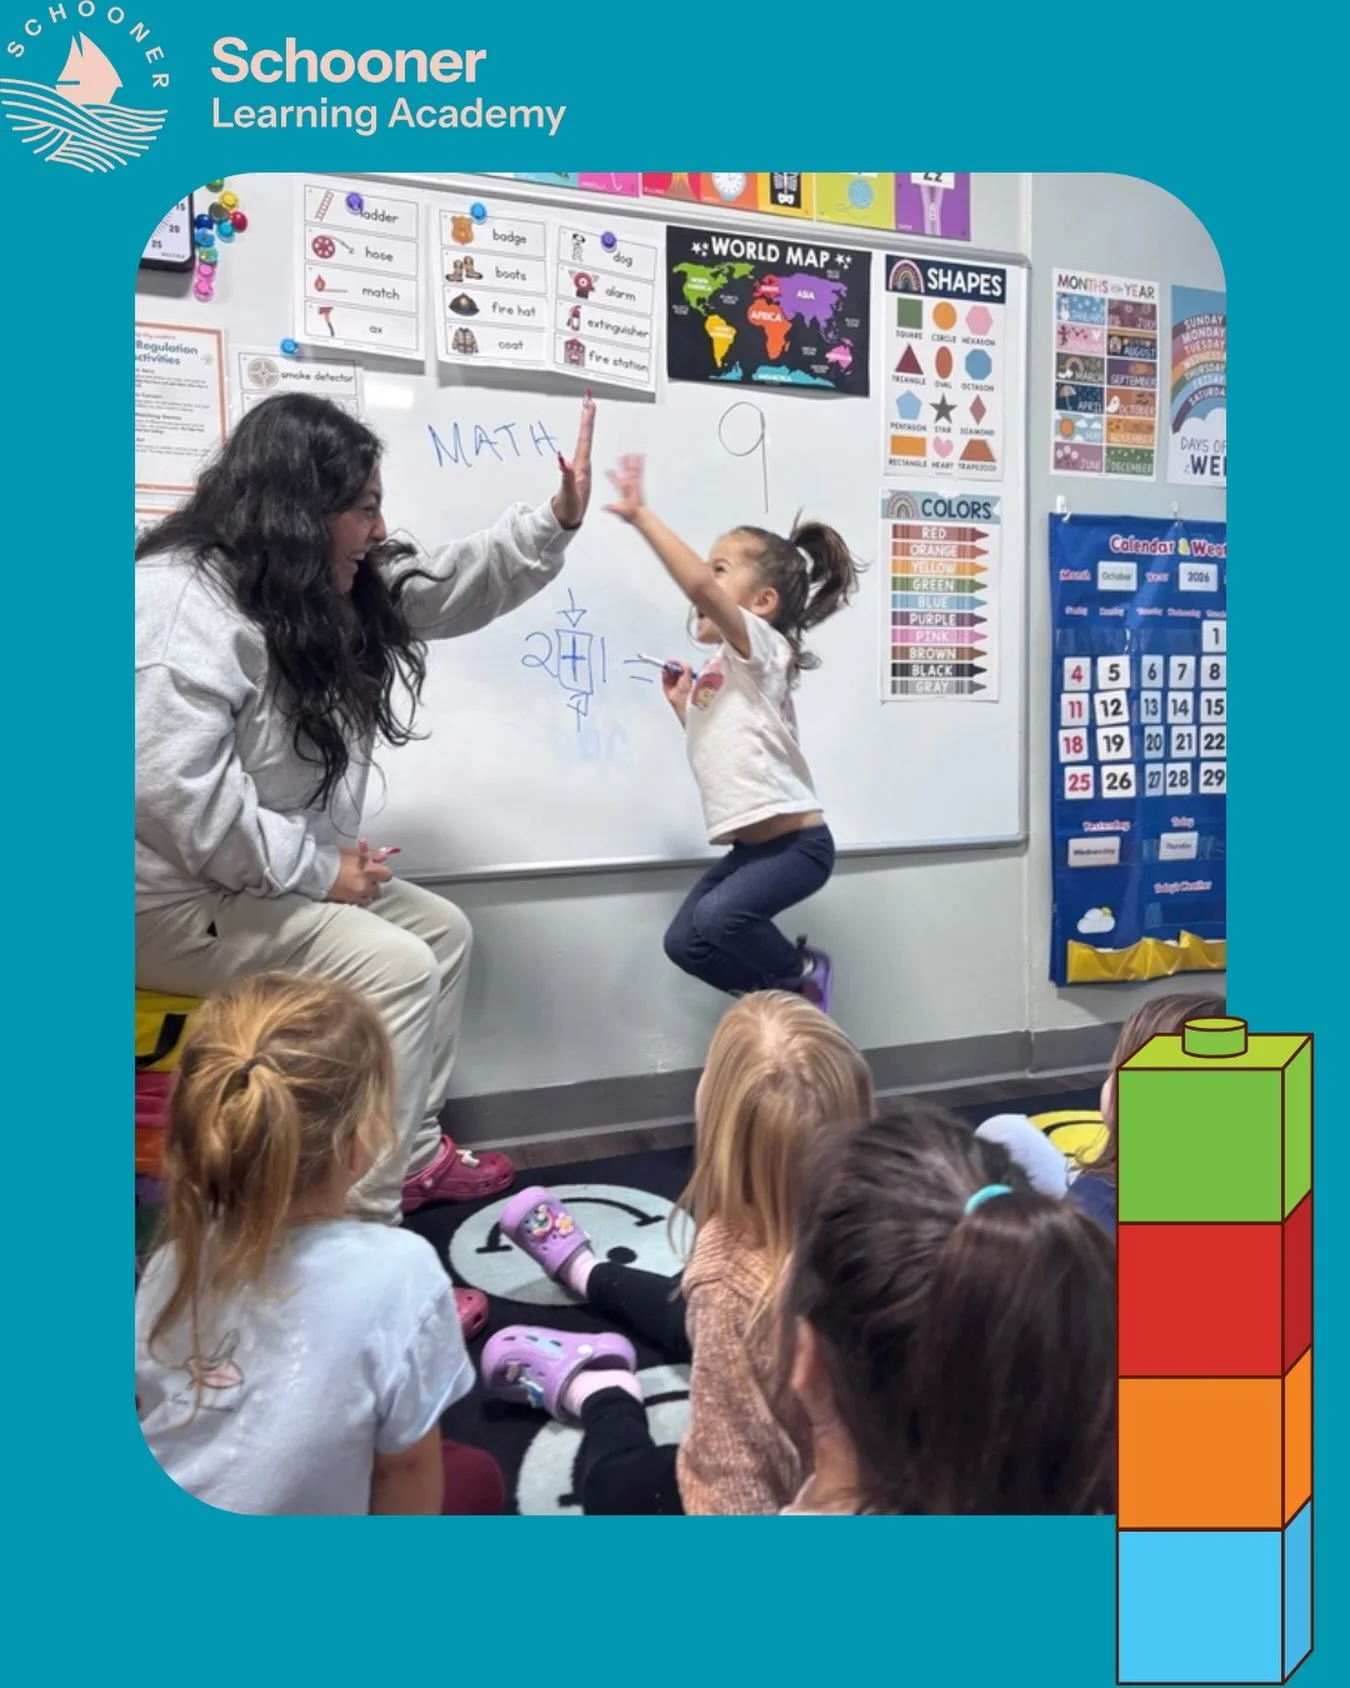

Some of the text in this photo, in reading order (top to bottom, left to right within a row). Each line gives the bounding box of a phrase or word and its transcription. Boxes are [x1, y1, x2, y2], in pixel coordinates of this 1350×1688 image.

[359, 205, 399, 224] ladder
[168, 224, 180, 233] 20
[492, 229, 527, 245] badge
[365, 247, 394, 262] hose
[711, 236, 831, 268] WORLD MAP
[613, 252, 633, 267] dog
[494, 266, 527, 281] boots
[927, 268, 1002, 297] SHAPES
[1058, 274, 1109, 294] MONTHS
[1124, 282, 1155, 299] YEAR
[362, 286, 400, 300] match
[605, 286, 636, 301] alarm
[796, 289, 816, 300] ASIA
[492, 303, 536, 317] fire hat
[750, 310, 782, 322] AFRICA
[587, 317, 649, 338] extinguisher
[1183, 314, 1224, 331] SUNDAY
[369, 325, 383, 335] ax
[896, 330, 923, 340] SQUARE
[1182, 326, 1226, 344] MONDAY
[498, 340, 524, 350] coat
[931, 334, 957, 343] CIRCLE
[136, 339, 198, 355] Regulation
[135, 352, 181, 365] ctivities
[589, 350, 649, 372] fire station
[280, 370, 354, 383] smoke detector
[892, 375, 926, 385] TRIANGLE
[961, 383, 994, 392] OCTAGON
[890, 422, 927, 432] PENTAGON
[934, 426, 952, 434] STAR
[427, 420, 560, 468] MATH
[1180, 436, 1210, 453] DAYS
[718, 401, 769, 514] 9
[889, 458, 927, 468] RECTANGLE
[931, 461, 954, 469] HEART
[921, 498, 992, 519] COLORS
[922, 527, 947, 539] RED
[910, 544, 958, 557] ORANGE
[1109, 533, 1175, 556] Calendar
[912, 561, 956, 574] YELLOW
[1186, 571, 1211, 583] 2026
[912, 578, 954, 591] GREEN
[918, 596, 948, 608] BLUE
[909, 613, 956, 626] PURPLE
[916, 630, 949, 642] PINK
[1211, 626, 1220, 646] 1
[909, 648, 957, 660] BROWN
[912, 664, 953, 676] BLACK
[1070, 662, 1221, 683] 4 5 6 7 8
[916, 680, 949, 693] GRAY
[1068, 697, 1225, 719] 11 12 13 14 15
[1062, 732, 1226, 754] 18 19 20 21 22
[1067, 768, 1226, 792] 25 26 27 28 29
